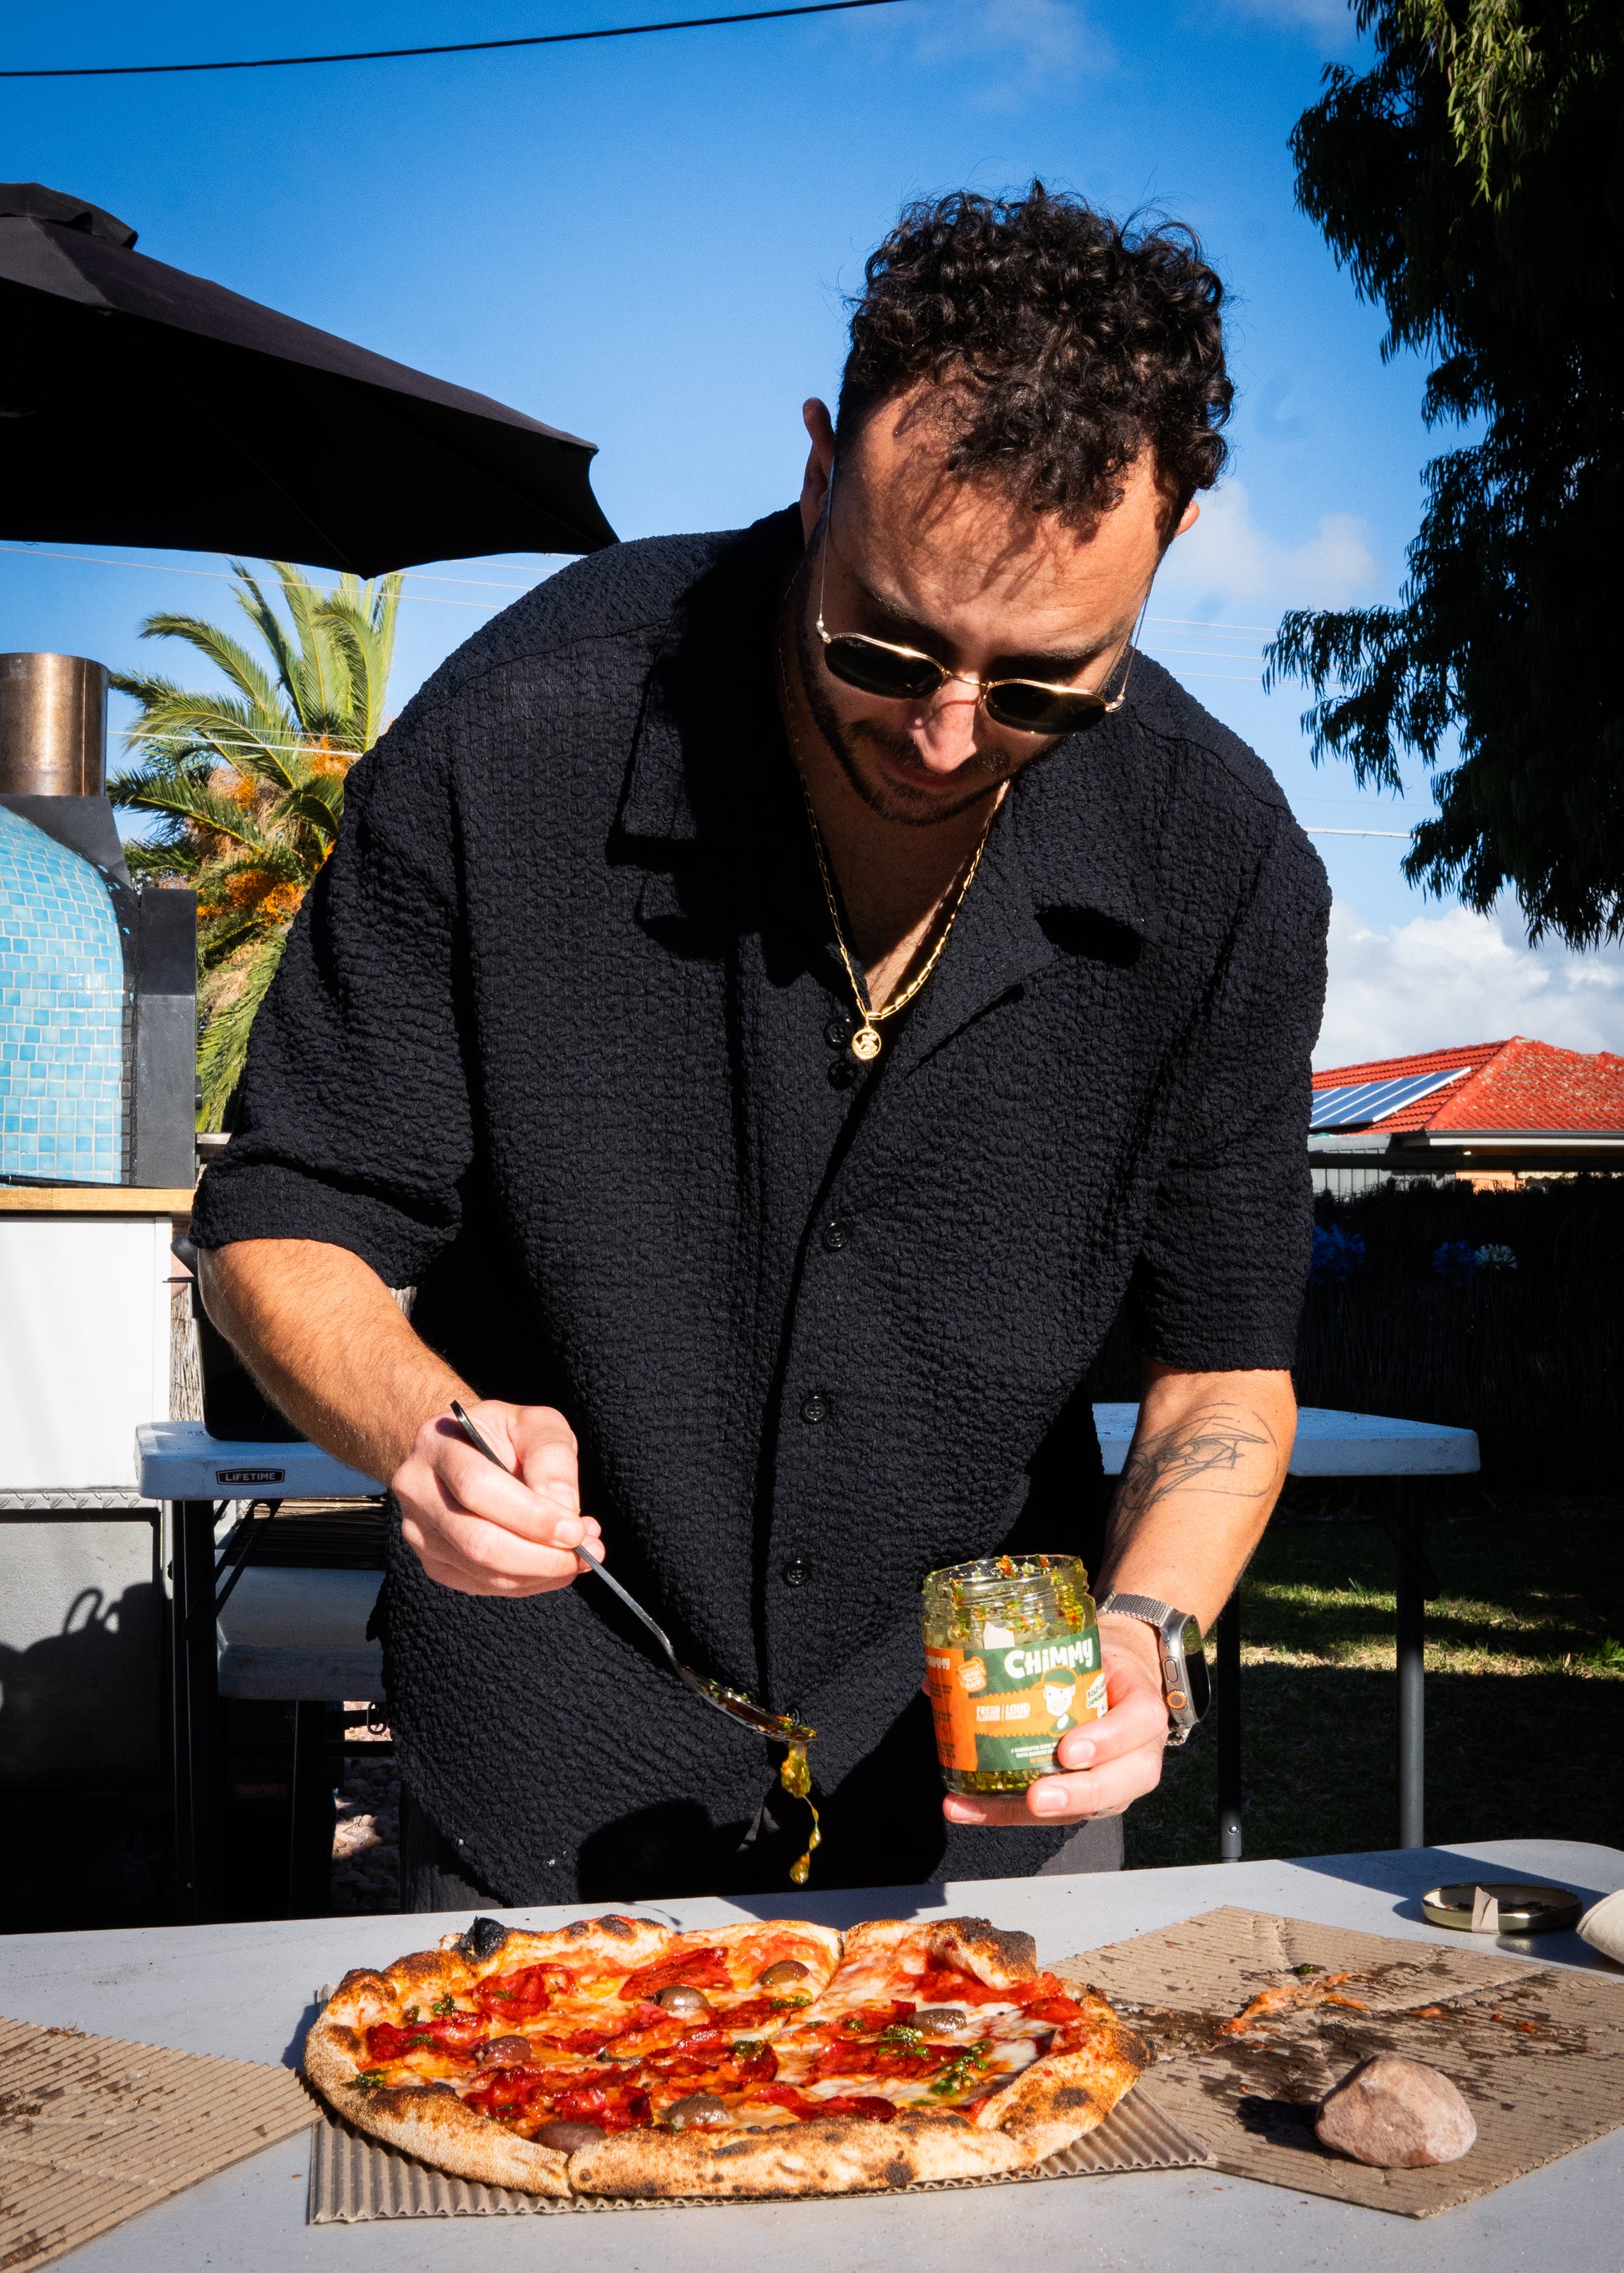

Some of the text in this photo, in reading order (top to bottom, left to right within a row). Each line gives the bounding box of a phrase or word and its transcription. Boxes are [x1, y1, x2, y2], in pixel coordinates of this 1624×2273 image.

[224, 1472, 276, 1482] LIFETIME
[976, 1705, 1001, 1715] FRESH
[1006, 1701, 1031, 1716] LOUD
